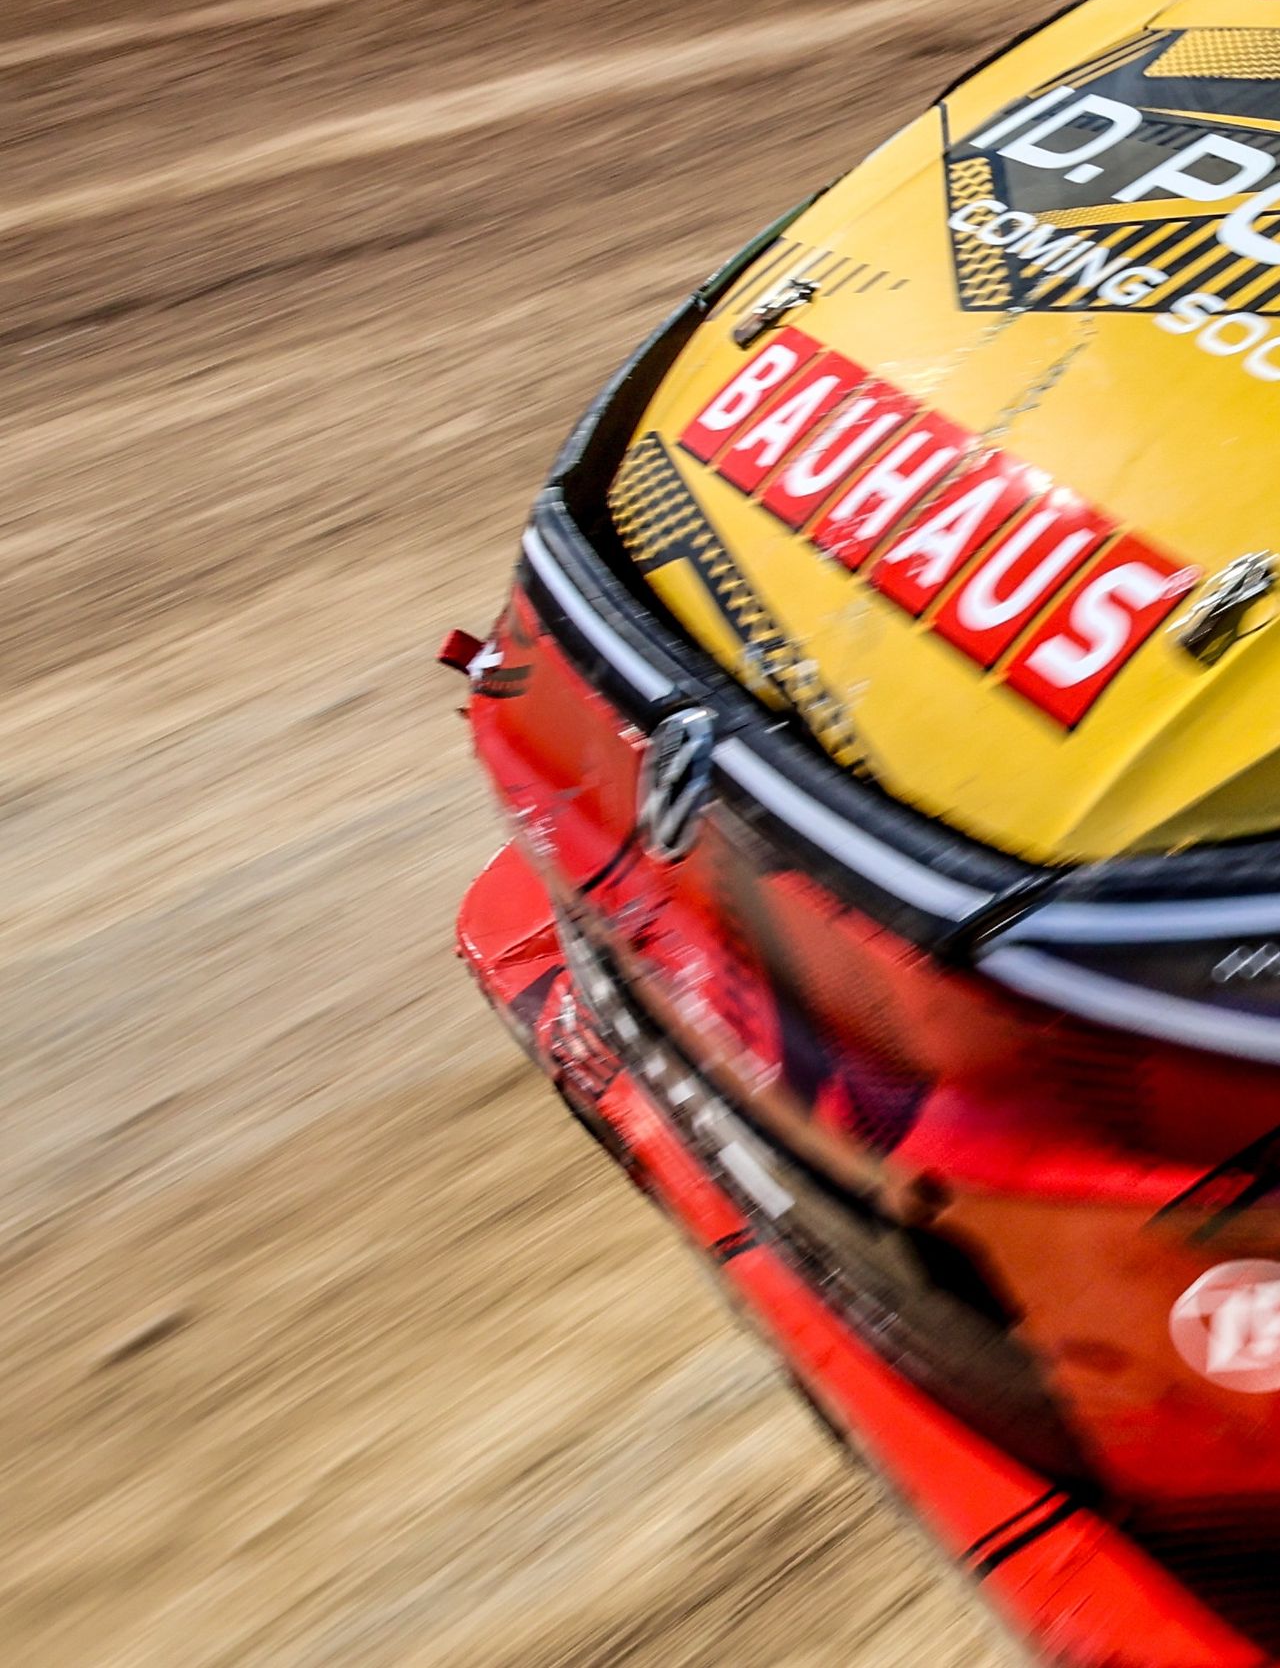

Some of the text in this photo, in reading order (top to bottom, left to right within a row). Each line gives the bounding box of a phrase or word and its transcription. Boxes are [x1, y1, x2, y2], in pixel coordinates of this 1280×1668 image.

[970, 85, 1143, 185] ID.
[946, 198, 1170, 308] COMING
[699, 342, 1168, 690] BAUHAUS
